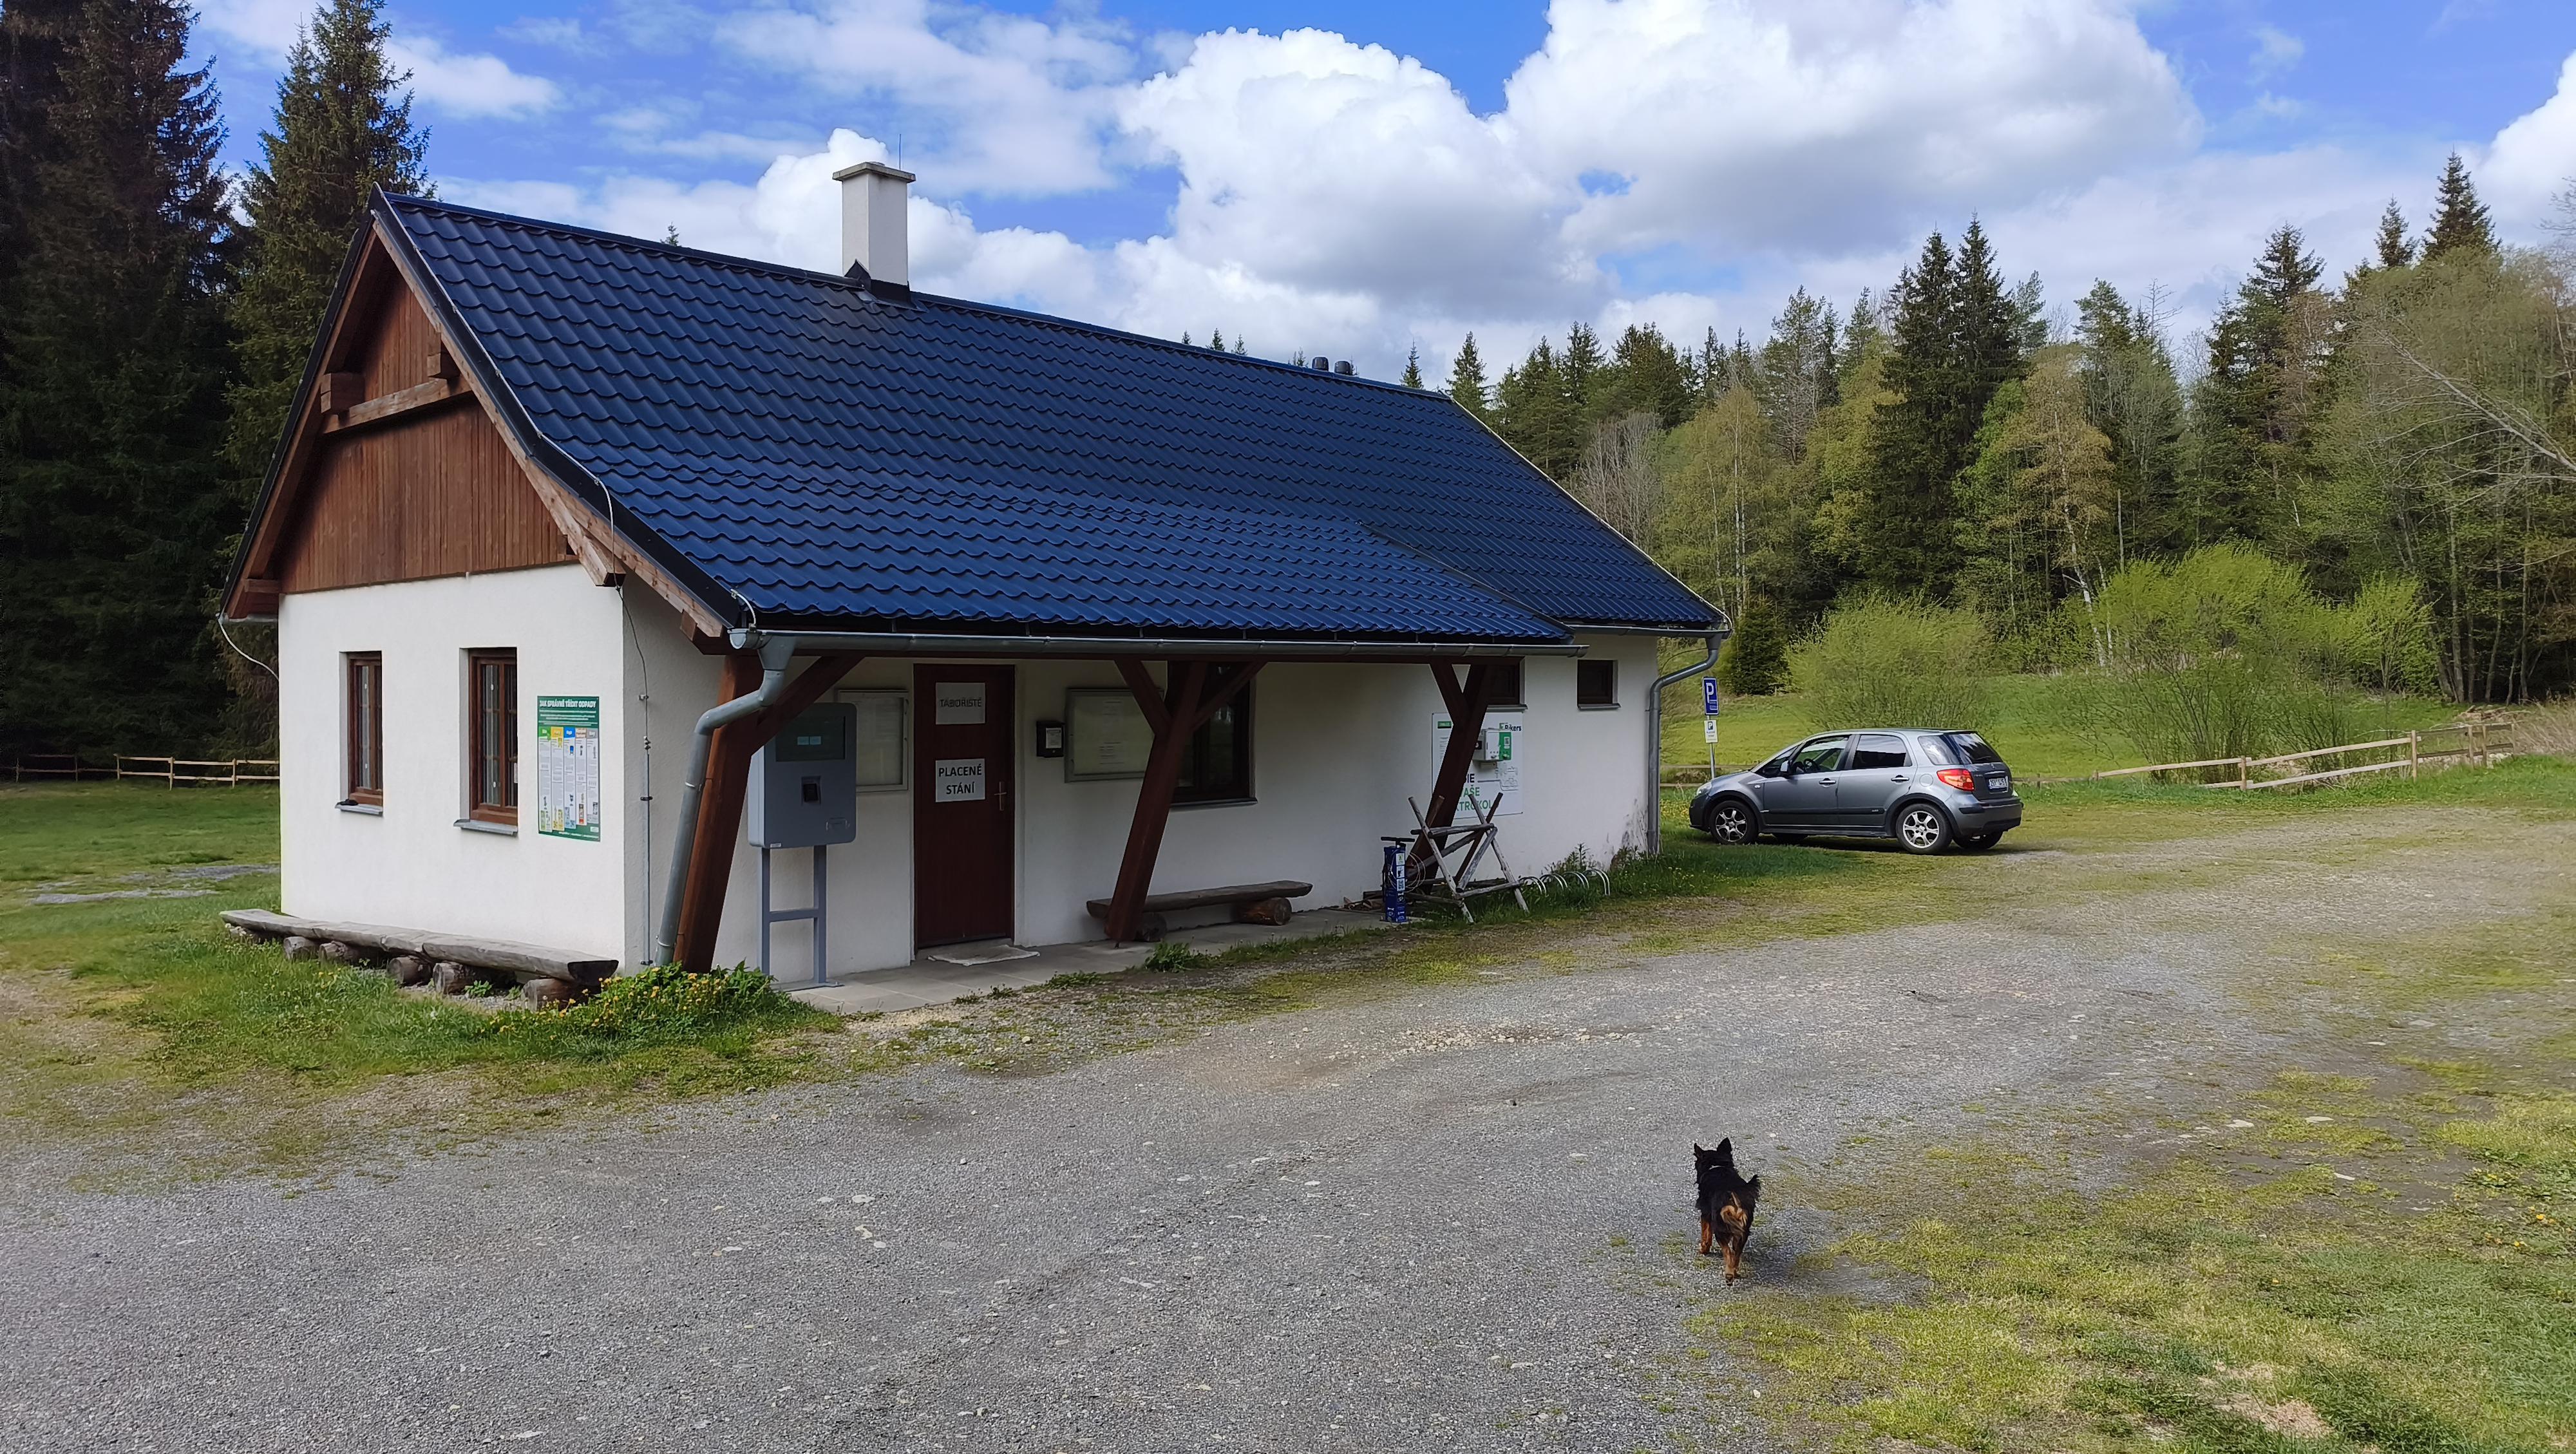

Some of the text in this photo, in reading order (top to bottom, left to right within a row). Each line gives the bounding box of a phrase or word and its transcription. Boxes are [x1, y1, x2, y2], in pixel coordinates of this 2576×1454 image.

[1706, 683, 1714, 704] P
[939, 763, 982, 777] PLACENÉ
[946, 781, 974, 795] STÁNÍ
